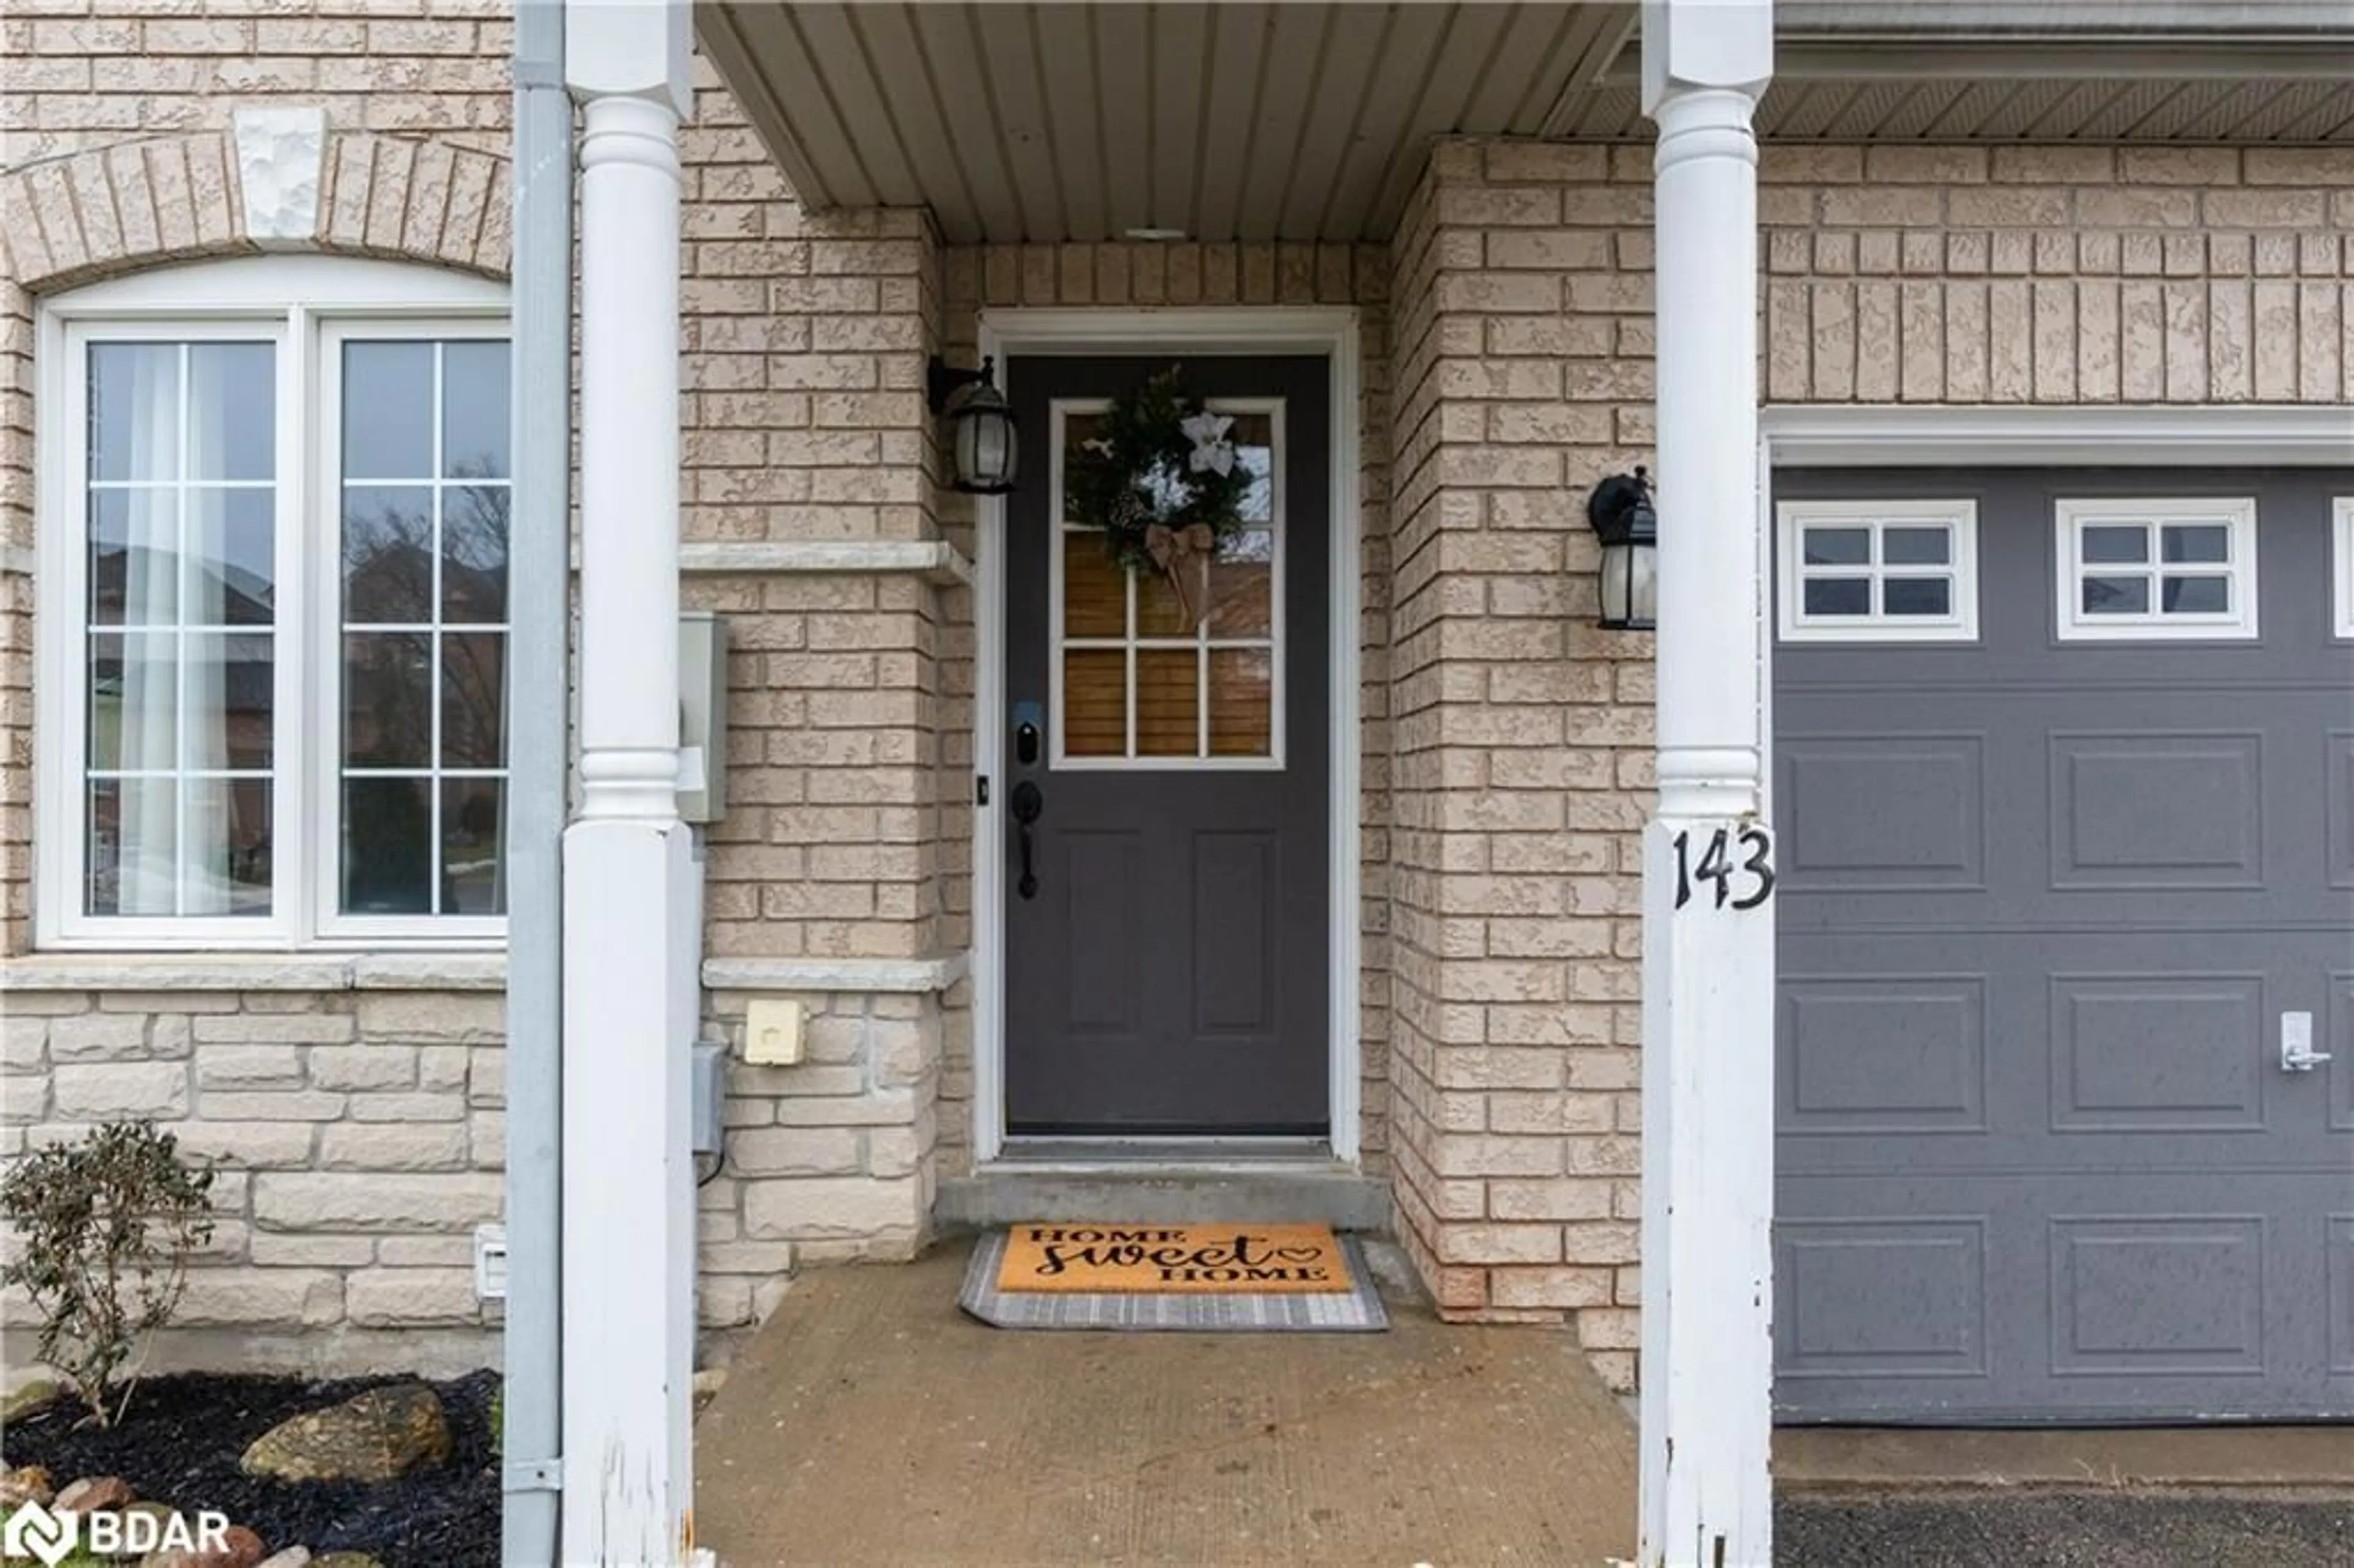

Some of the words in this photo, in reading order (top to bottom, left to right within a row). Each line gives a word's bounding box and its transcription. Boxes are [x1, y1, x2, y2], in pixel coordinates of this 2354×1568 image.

[1673, 829, 1775, 910] 143
[1030, 1229, 1187, 1243] HOME
[1035, 1235, 1275, 1274] sweet
[1160, 1266, 1328, 1281] HOME
